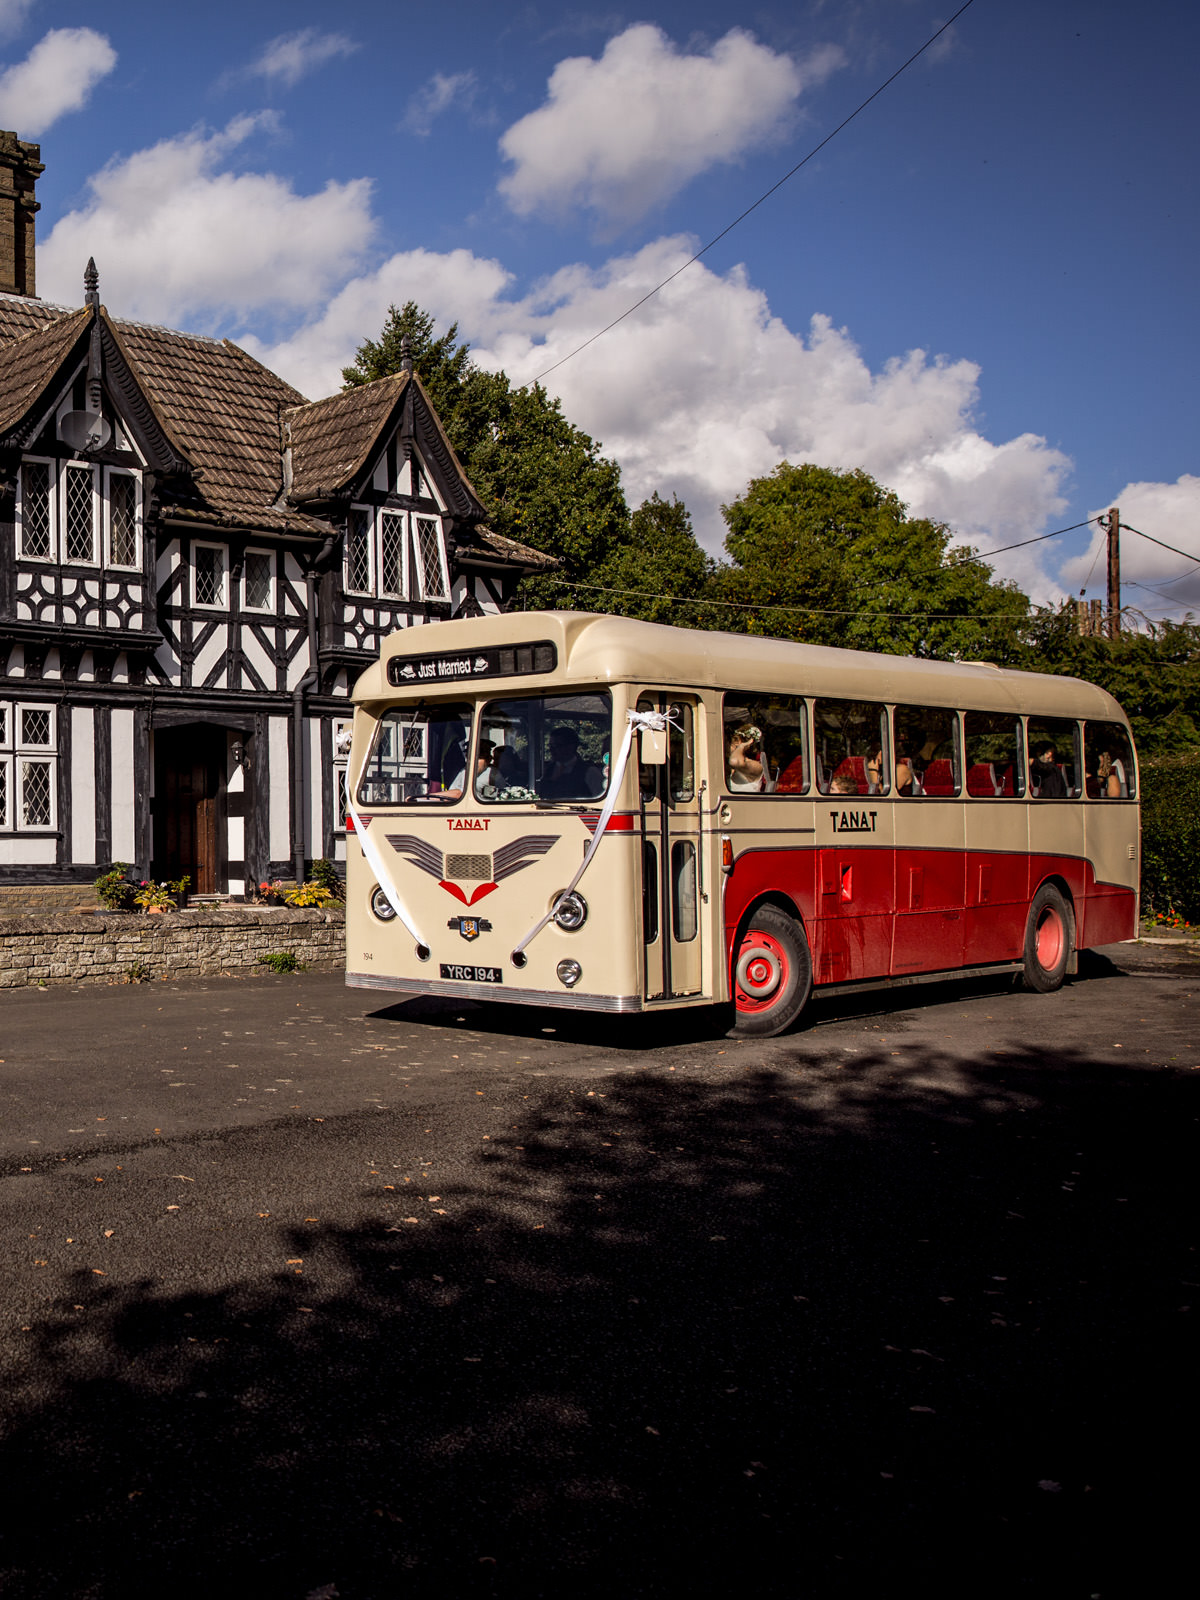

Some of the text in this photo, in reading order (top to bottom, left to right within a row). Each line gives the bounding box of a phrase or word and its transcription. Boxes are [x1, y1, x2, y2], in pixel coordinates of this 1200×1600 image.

[417, 658, 471, 678] Just Married
[446, 819, 491, 831] TANAT
[830, 811, 877, 832] TANAT
[447, 965, 495, 982] YRC 194
